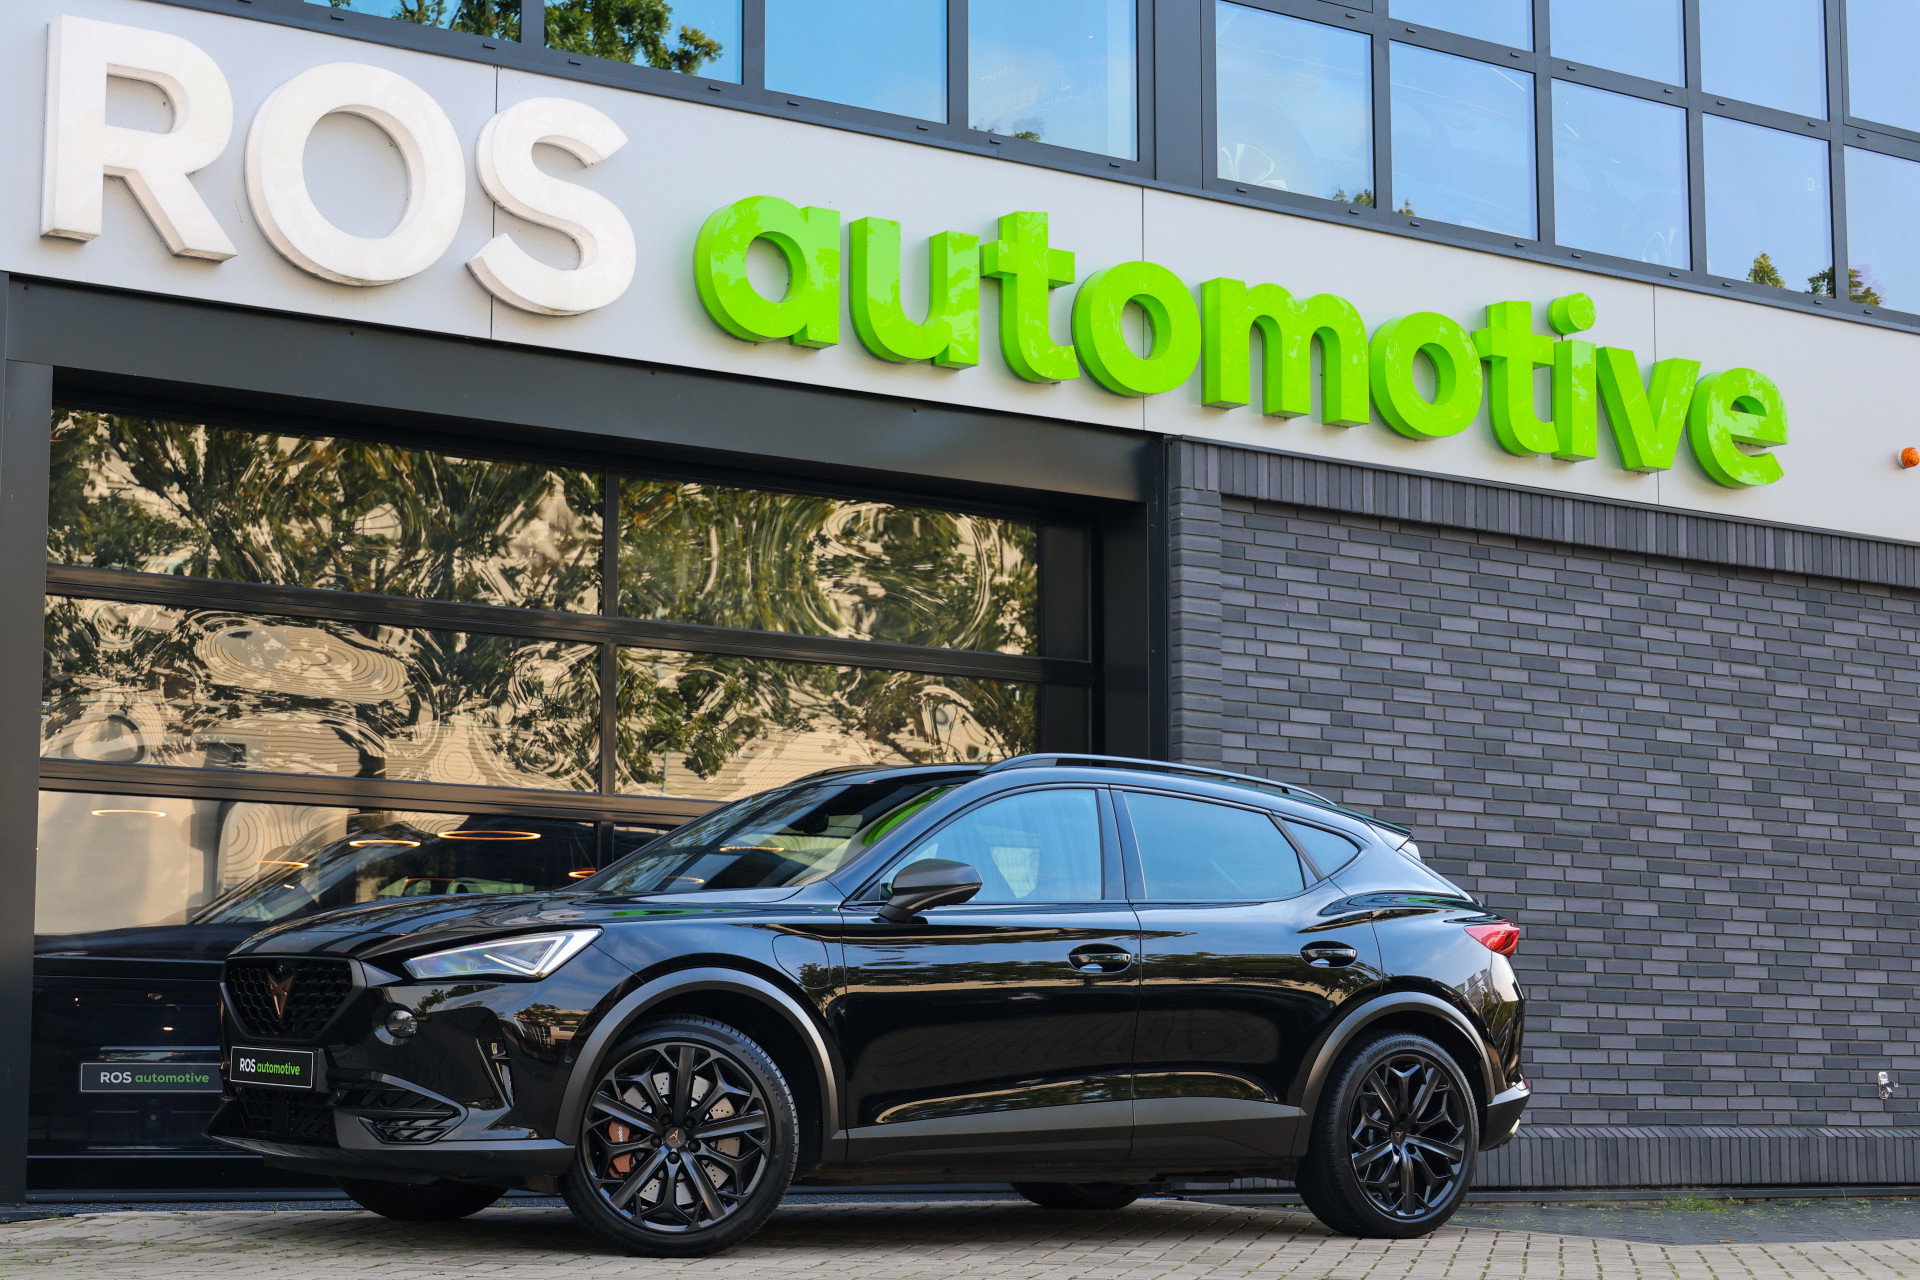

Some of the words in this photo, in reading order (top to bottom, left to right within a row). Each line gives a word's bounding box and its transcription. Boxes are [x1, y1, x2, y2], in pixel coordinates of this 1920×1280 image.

[40, 15, 637, 316] ROS
[694, 195, 1788, 489] automotive
[239, 1057, 256, 1074] ROS
[257, 1060, 301, 1076] automotive
[100, 1071, 132, 1084] ROS
[135, 1072, 210, 1084] automotive
